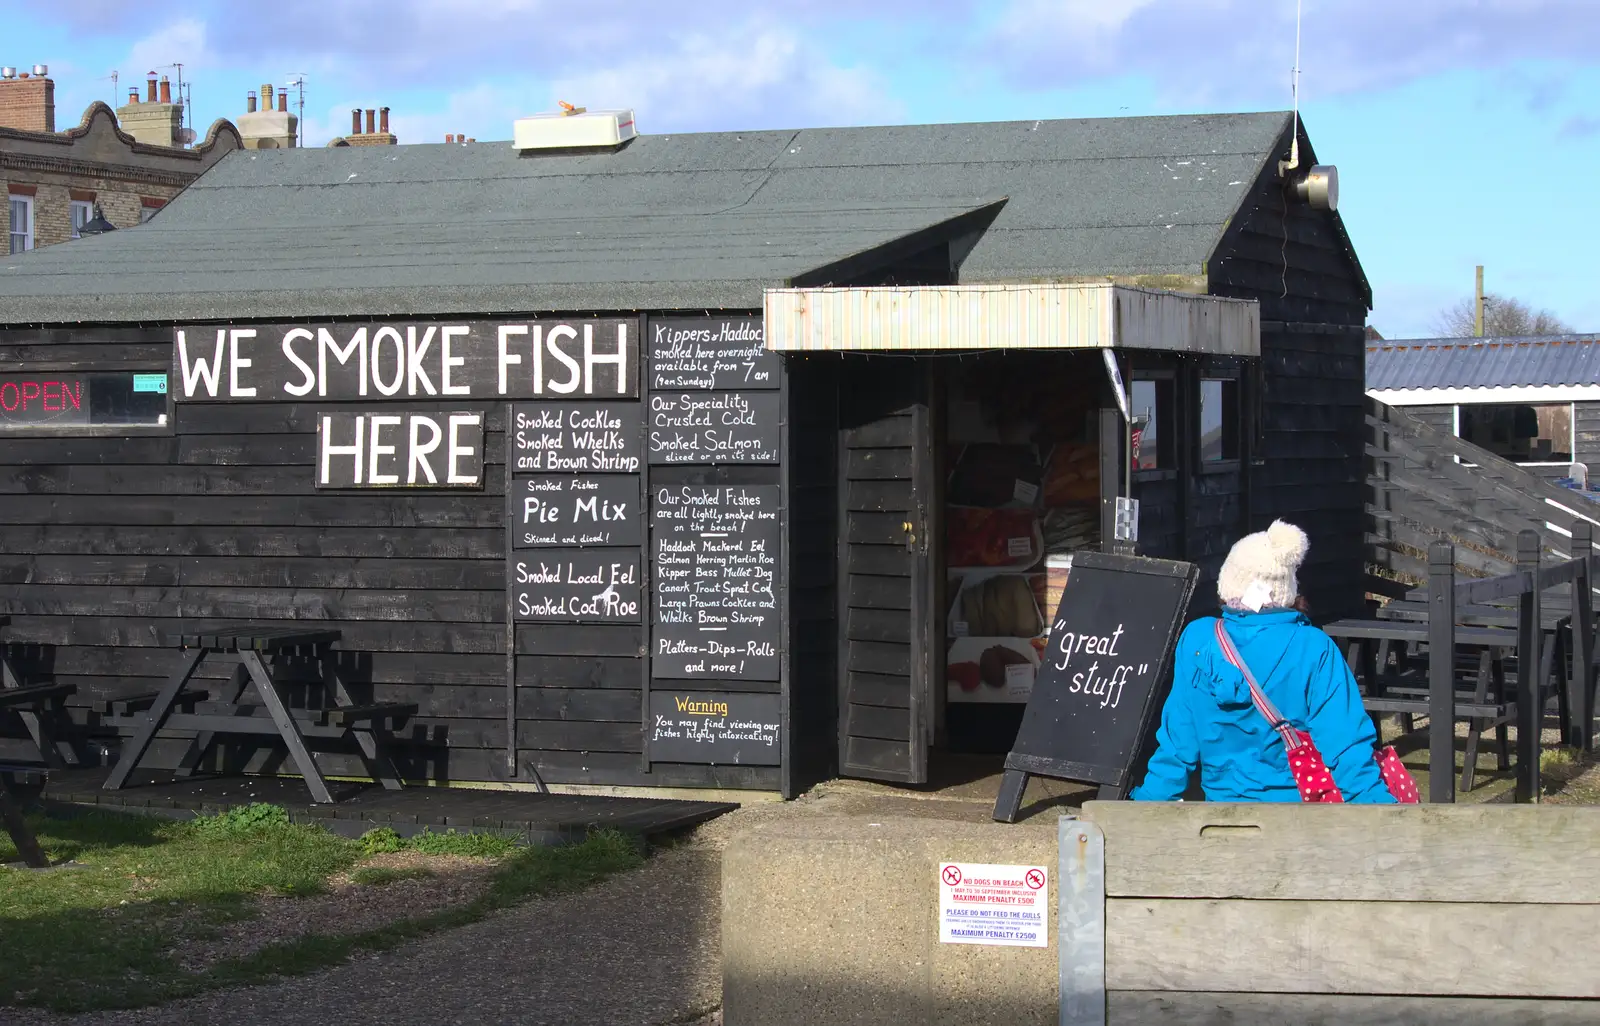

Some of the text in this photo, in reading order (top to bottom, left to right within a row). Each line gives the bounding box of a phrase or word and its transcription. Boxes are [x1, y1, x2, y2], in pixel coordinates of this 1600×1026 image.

[656, 324, 710, 351] Kippers
[720, 322, 765, 341] Haddoc
[177, 323, 627, 397] WE SMOKE FISH
[654, 343, 764, 360] smoked here overnight
[655, 359, 708, 371] available
[710, 361, 737, 374] from
[742, 362, 755, 382] 7
[677, 373, 715, 389] Sundays)
[0, 381, 81, 412] OPEN
[652, 394, 748, 415] Our Speciality
[517, 410, 621, 428] Smoked Cockles
[655, 410, 756, 427] Crusted Cold
[517, 431, 624, 449] Smoked Whelks
[651, 430, 760, 451] Smoked Salmon
[321, 415, 481, 484] HERE
[665, 452, 694, 461] sliced
[518, 450, 638, 472] and Brown Shrimp
[528, 480, 598, 491] Smoked Fishes
[659, 486, 760, 505] Our Smoked Fishes
[524, 496, 626, 523] Pie Mix
[657, 506, 775, 523] are all lightly smoked here
[690, 522, 704, 531] the
[524, 533, 557, 543] Skinned
[562, 535, 576, 543] and
[660, 539, 765, 552] Haddock Mackerel Eel
[658, 553, 774, 566] Salmon Herring Marlin Roe
[517, 563, 635, 584] Smoked Local Eel
[659, 566, 772, 581] Kipper Bass Mullet Dog
[694, 581, 720, 592] Trout
[723, 581, 749, 597] Sprat
[752, 582, 772, 593] Cod
[519, 592, 637, 616] Smoked Cod Roe
[660, 594, 776, 612] Large Prawns Cockles and
[660, 610, 764, 626] Whelks Brown Shrimp
[685, 660, 705, 672] and
[675, 696, 728, 716] Warning
[656, 715, 673, 726] You
[679, 721, 697, 731] may
[704, 718, 725, 731] find
[730, 720, 761, 732] viewing
[653, 728, 778, 746] fishes highly intoxicating!
[951, 929, 984, 937] MAXIMUM
